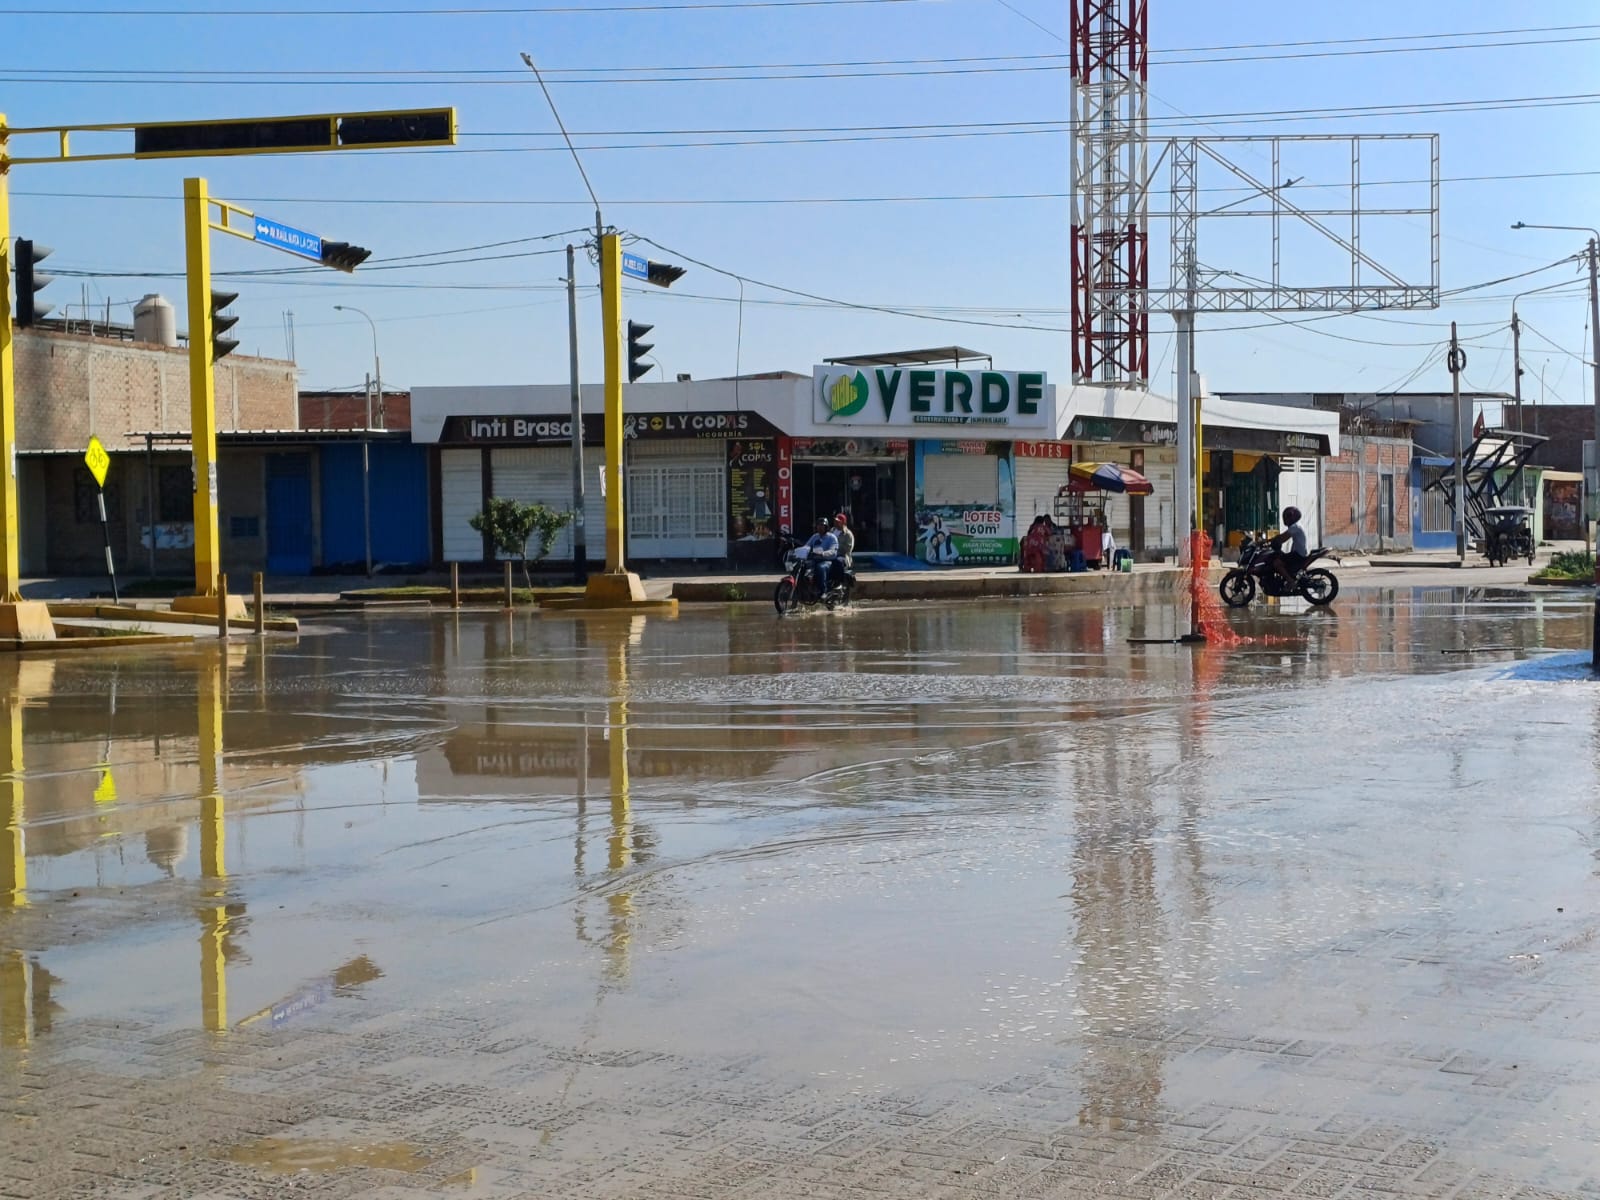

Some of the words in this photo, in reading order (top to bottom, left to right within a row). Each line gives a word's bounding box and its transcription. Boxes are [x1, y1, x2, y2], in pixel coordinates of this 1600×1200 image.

[307, 239, 319, 252] CRUZ
[875, 369, 1043, 423] VERDE
[471, 417, 507, 438] Inti
[514, 418, 586, 437] Brasa
[638, 415, 675, 431] SOL
[678, 415, 690, 429] Y
[692, 414, 748, 430] COPAS
[749, 441, 765, 450] SOL
[1021, 443, 1063, 458] LOTES
[741, 453, 772, 462] COPAS
[778, 447, 790, 535] LOTES
[964, 511, 1001, 523] LOTES
[965, 523, 1000, 535] 160m²
